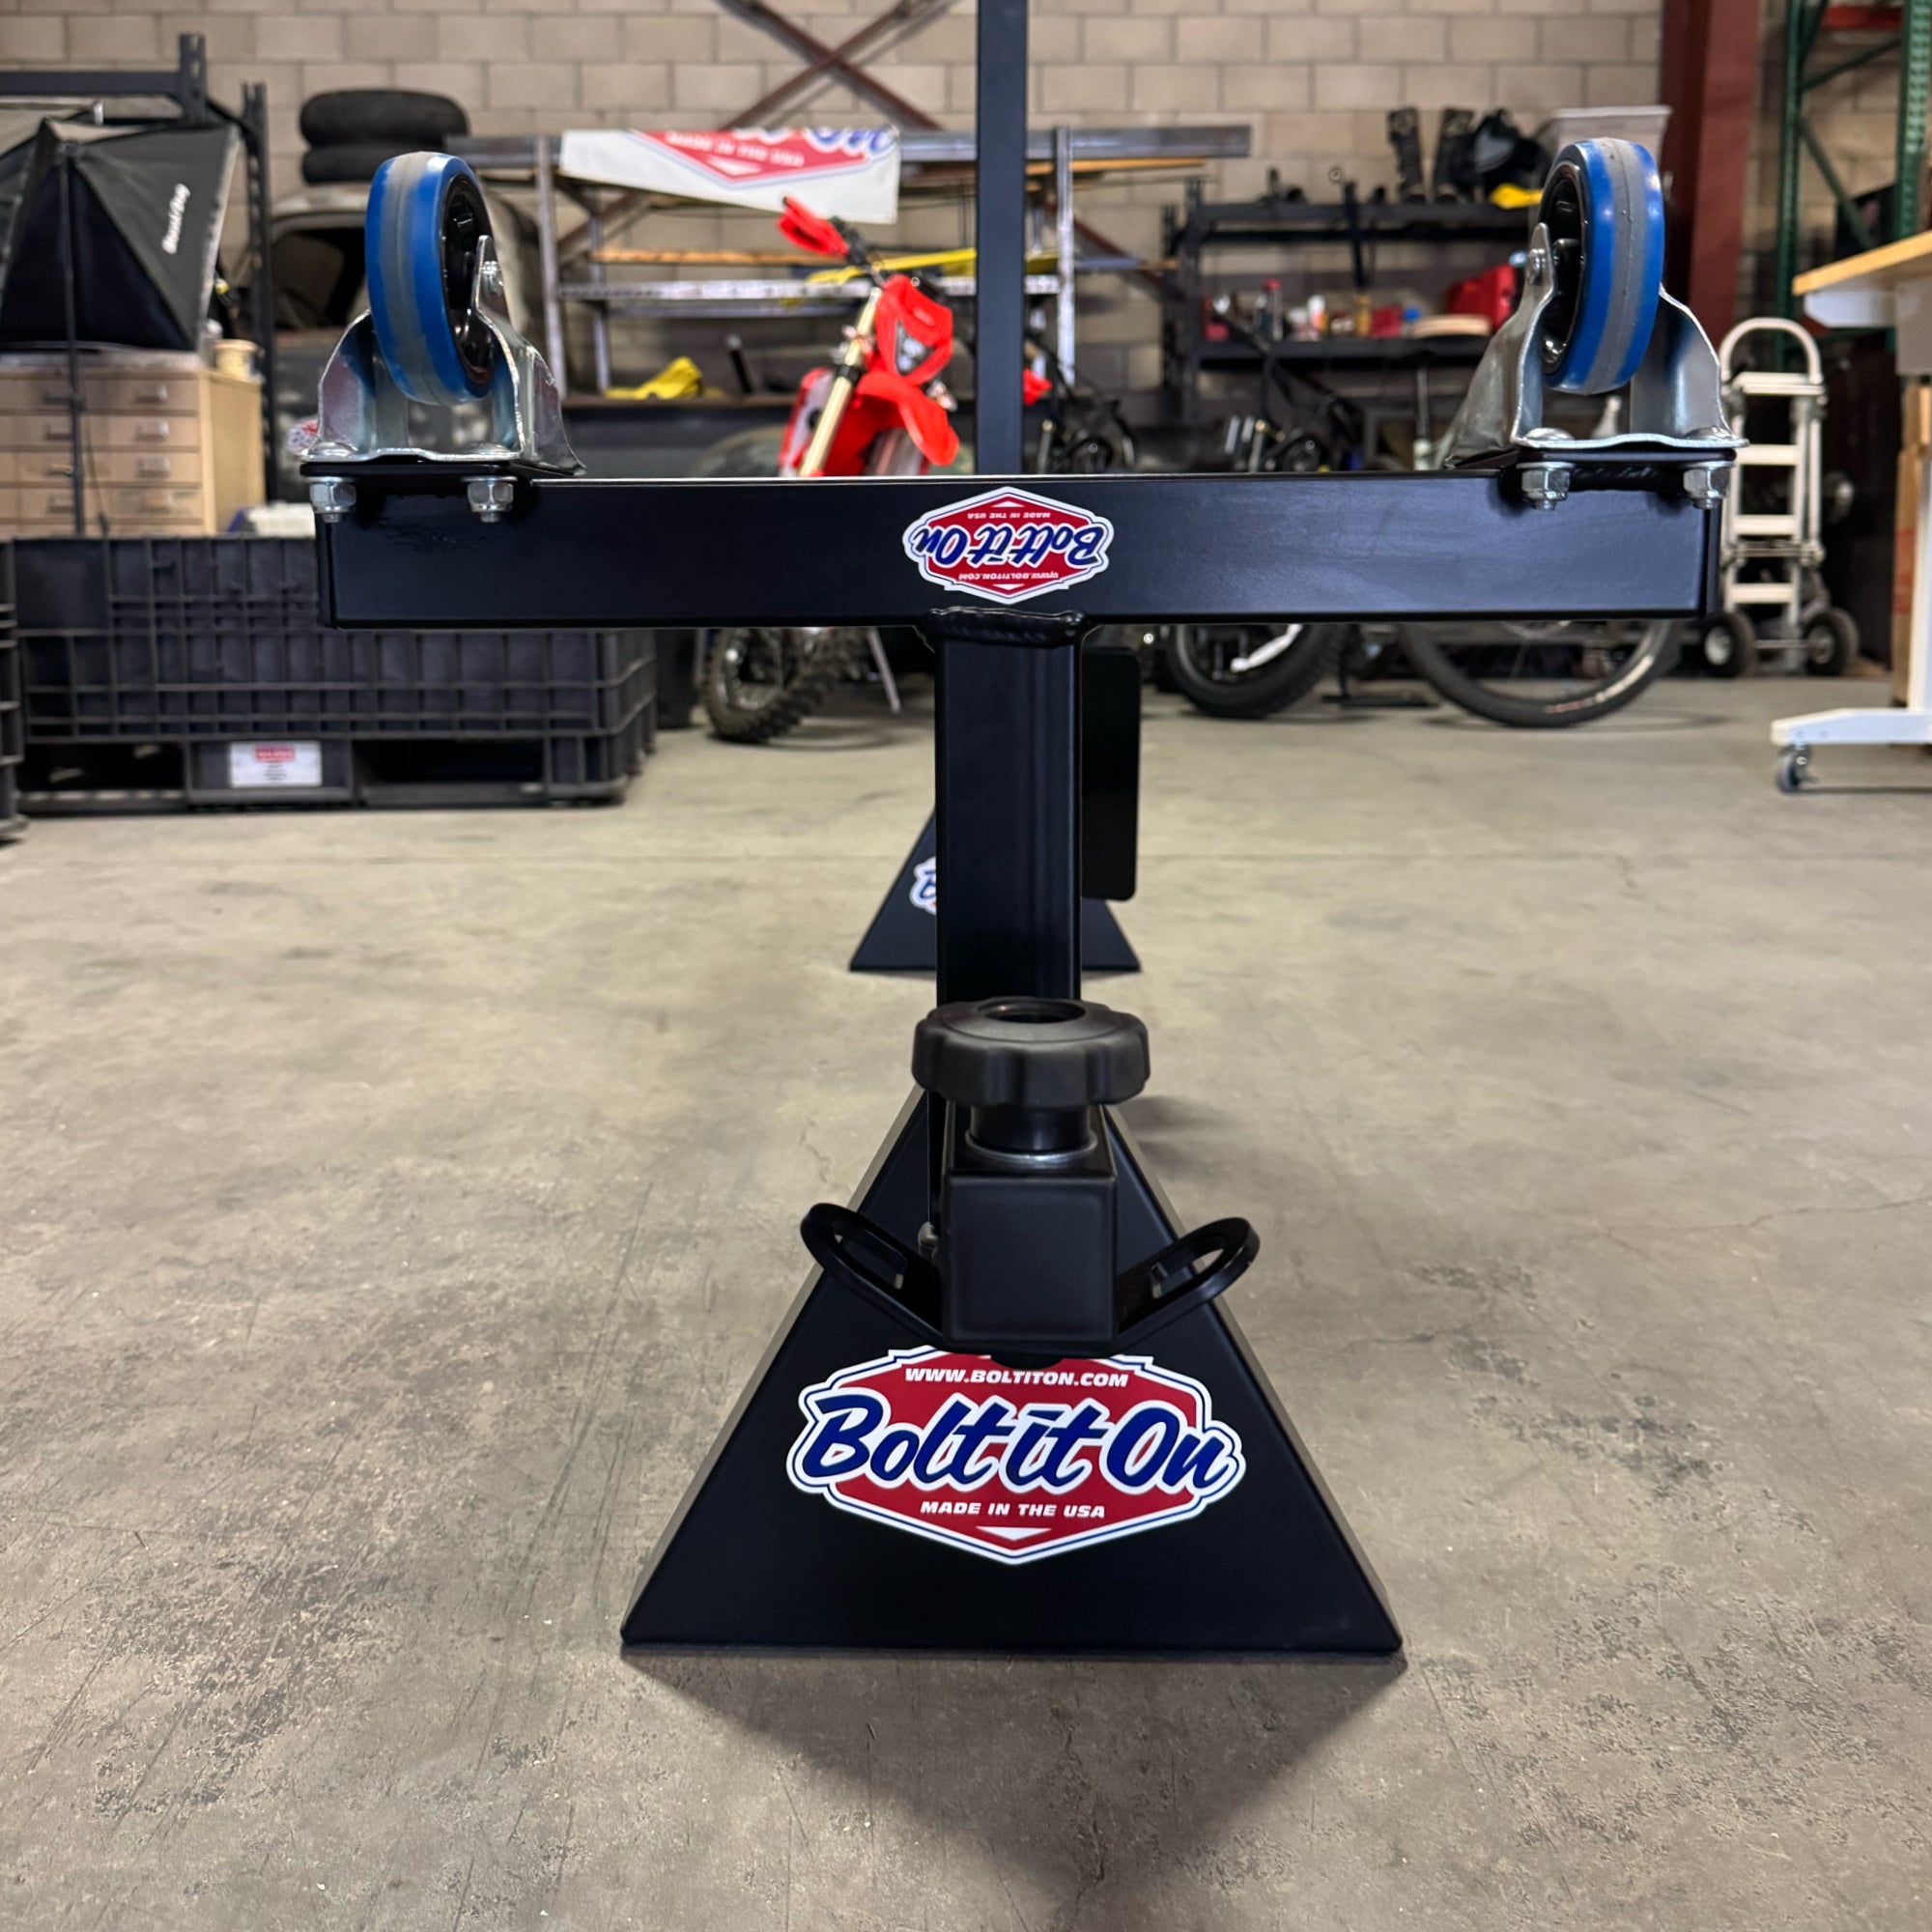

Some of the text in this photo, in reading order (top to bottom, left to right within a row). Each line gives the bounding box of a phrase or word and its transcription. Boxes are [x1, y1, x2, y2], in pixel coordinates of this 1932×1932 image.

[958, 571, 1059, 581] WWW.BOLTITON.COM
[904, 1367, 1129, 1388] WWW.BOLTITON.COM
[802, 1394, 1016, 1485] Bolt
[1107, 1407, 1230, 1489] On
[920, 1500, 1105, 1519] MADE IN THE USA
